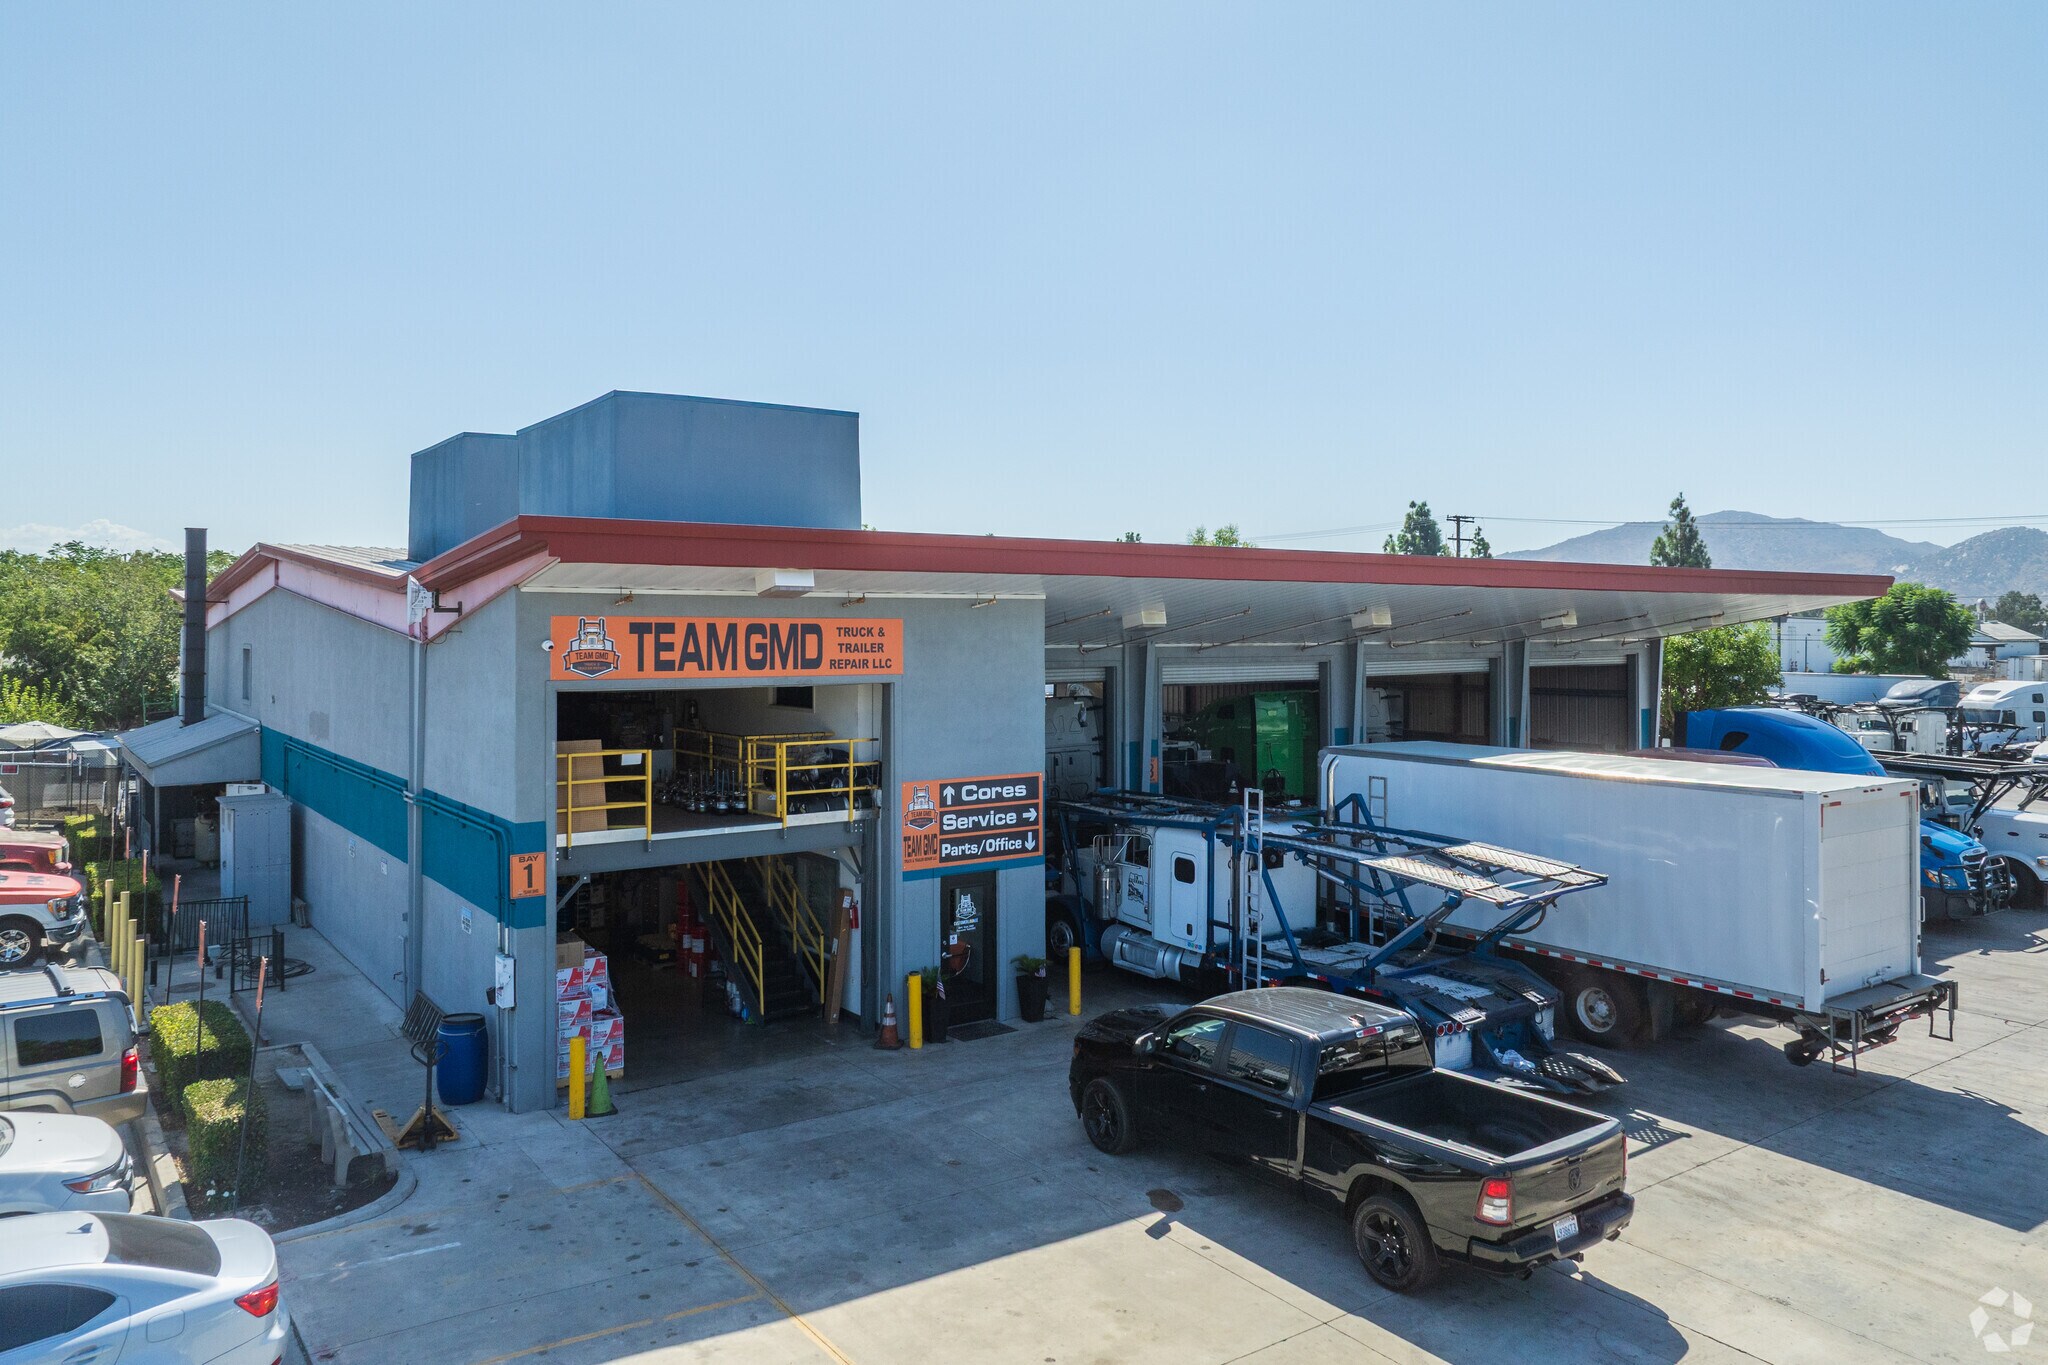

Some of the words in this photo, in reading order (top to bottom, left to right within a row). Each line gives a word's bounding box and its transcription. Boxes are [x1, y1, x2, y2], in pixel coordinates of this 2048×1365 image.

[836, 627, 874, 637] TRUCK
[877, 627, 885, 637] &
[575, 651, 593, 660] TEAM
[595, 651, 609, 660] GMD
[629, 622, 737, 672] TEAM
[745, 623, 823, 671] GMD
[838, 643, 884, 653] TRAILER
[829, 659, 869, 669] REPAIR
[872, 658, 892, 669] LLC
[961, 784, 1027, 801] Cores
[942, 810, 1017, 831] Service
[903, 834, 922, 858] TEAM
[923, 833, 938, 856] GMD
[941, 837, 1022, 857] Parts/Office
[518, 855, 539, 863] BAY
[523, 863, 533, 888] 1
